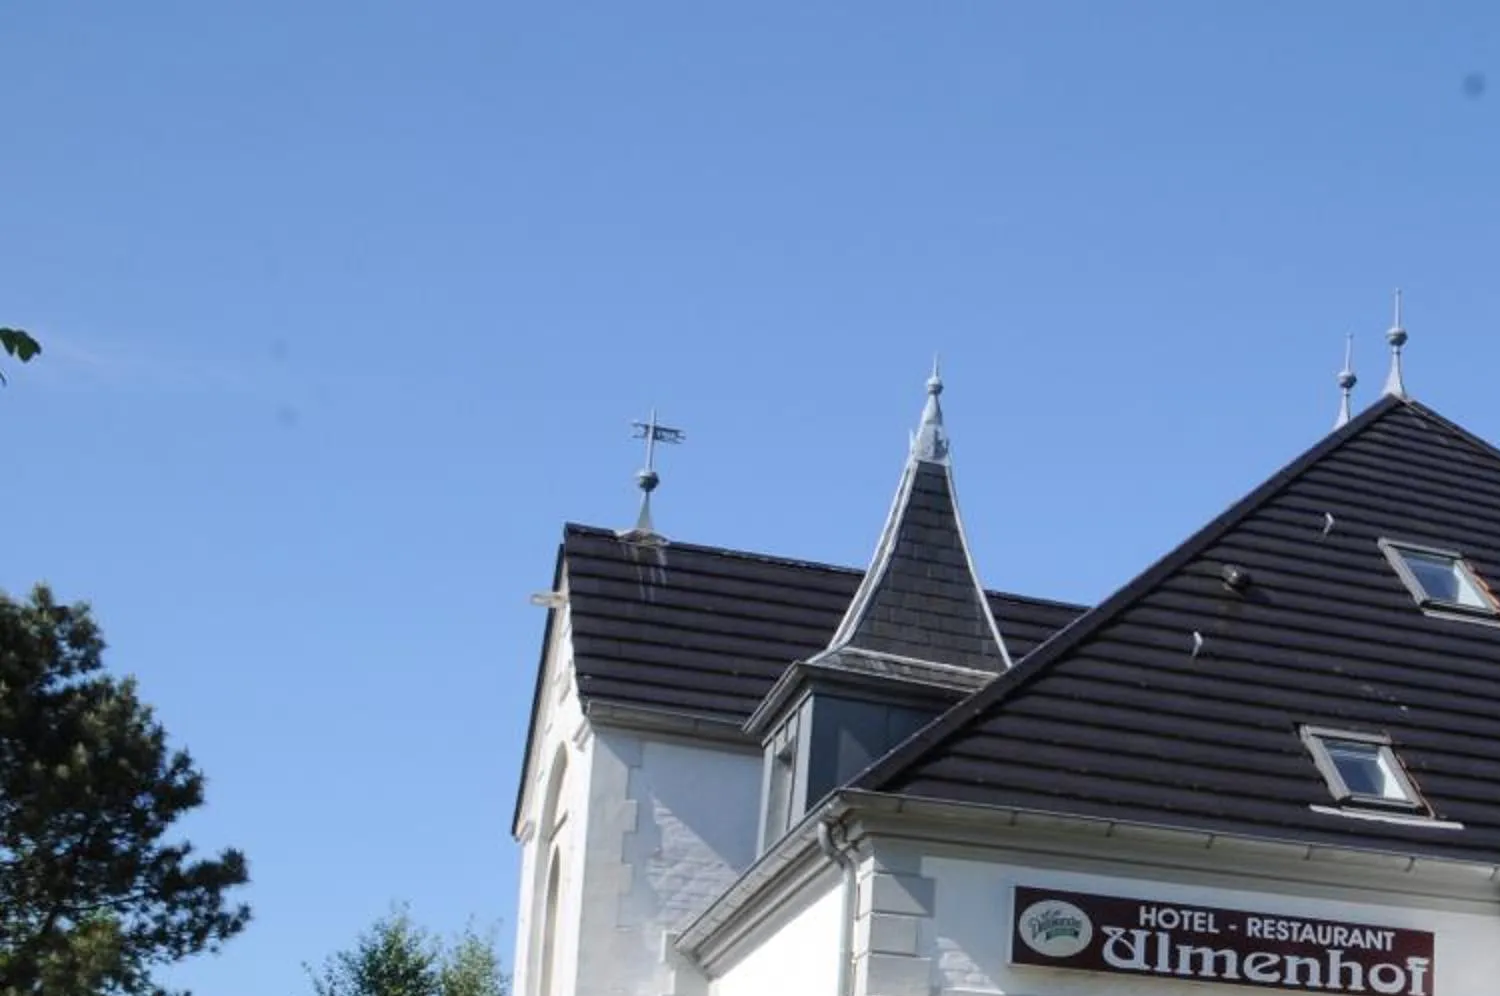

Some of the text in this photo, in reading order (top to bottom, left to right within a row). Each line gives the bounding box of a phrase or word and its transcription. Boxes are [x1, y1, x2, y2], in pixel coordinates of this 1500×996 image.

[1139, 905, 1220, 934] HOTEL
[1247, 917, 1396, 951] RESTAURANT
[1100, 925, 1430, 996] Ulmenhof
